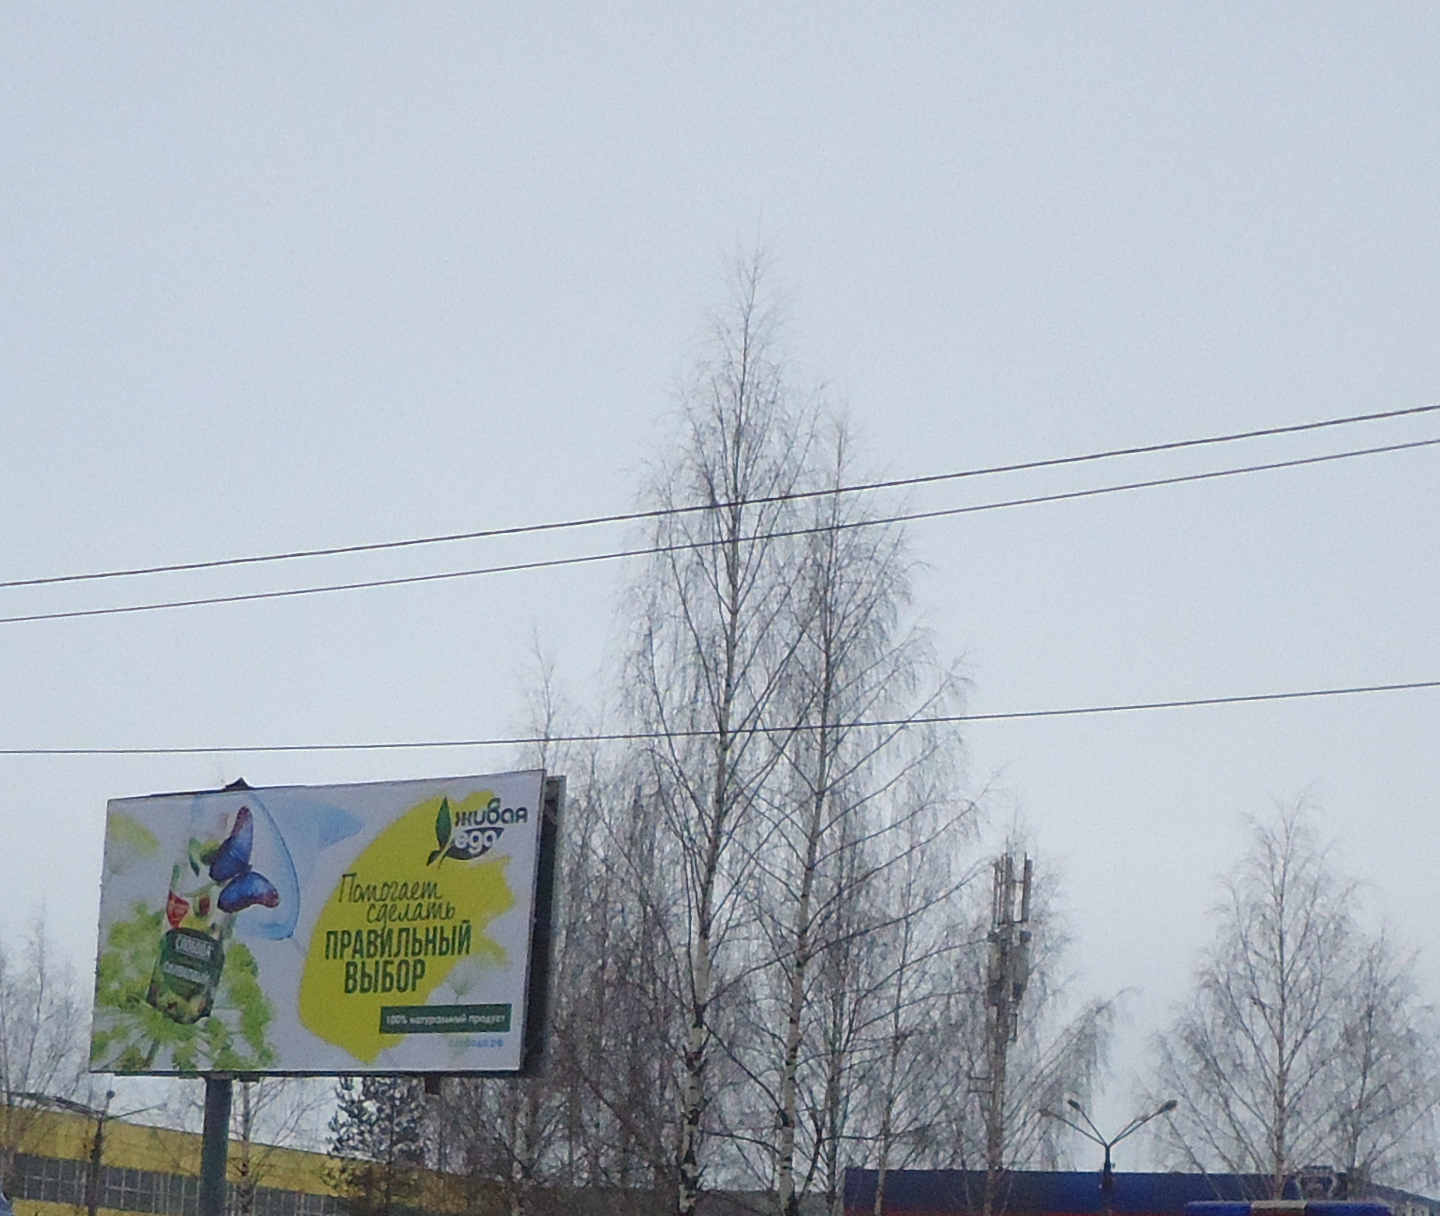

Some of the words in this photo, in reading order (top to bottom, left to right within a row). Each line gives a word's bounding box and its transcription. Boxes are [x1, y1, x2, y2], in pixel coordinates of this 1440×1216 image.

[454, 798, 528, 826] живая
[339, 873, 443, 904] Помогает
[366, 900, 456, 929] сделать
[325, 919, 472, 960] ПРАВИЛЬНЫЙ
[344, 958, 426, 994] ВЫБОР
